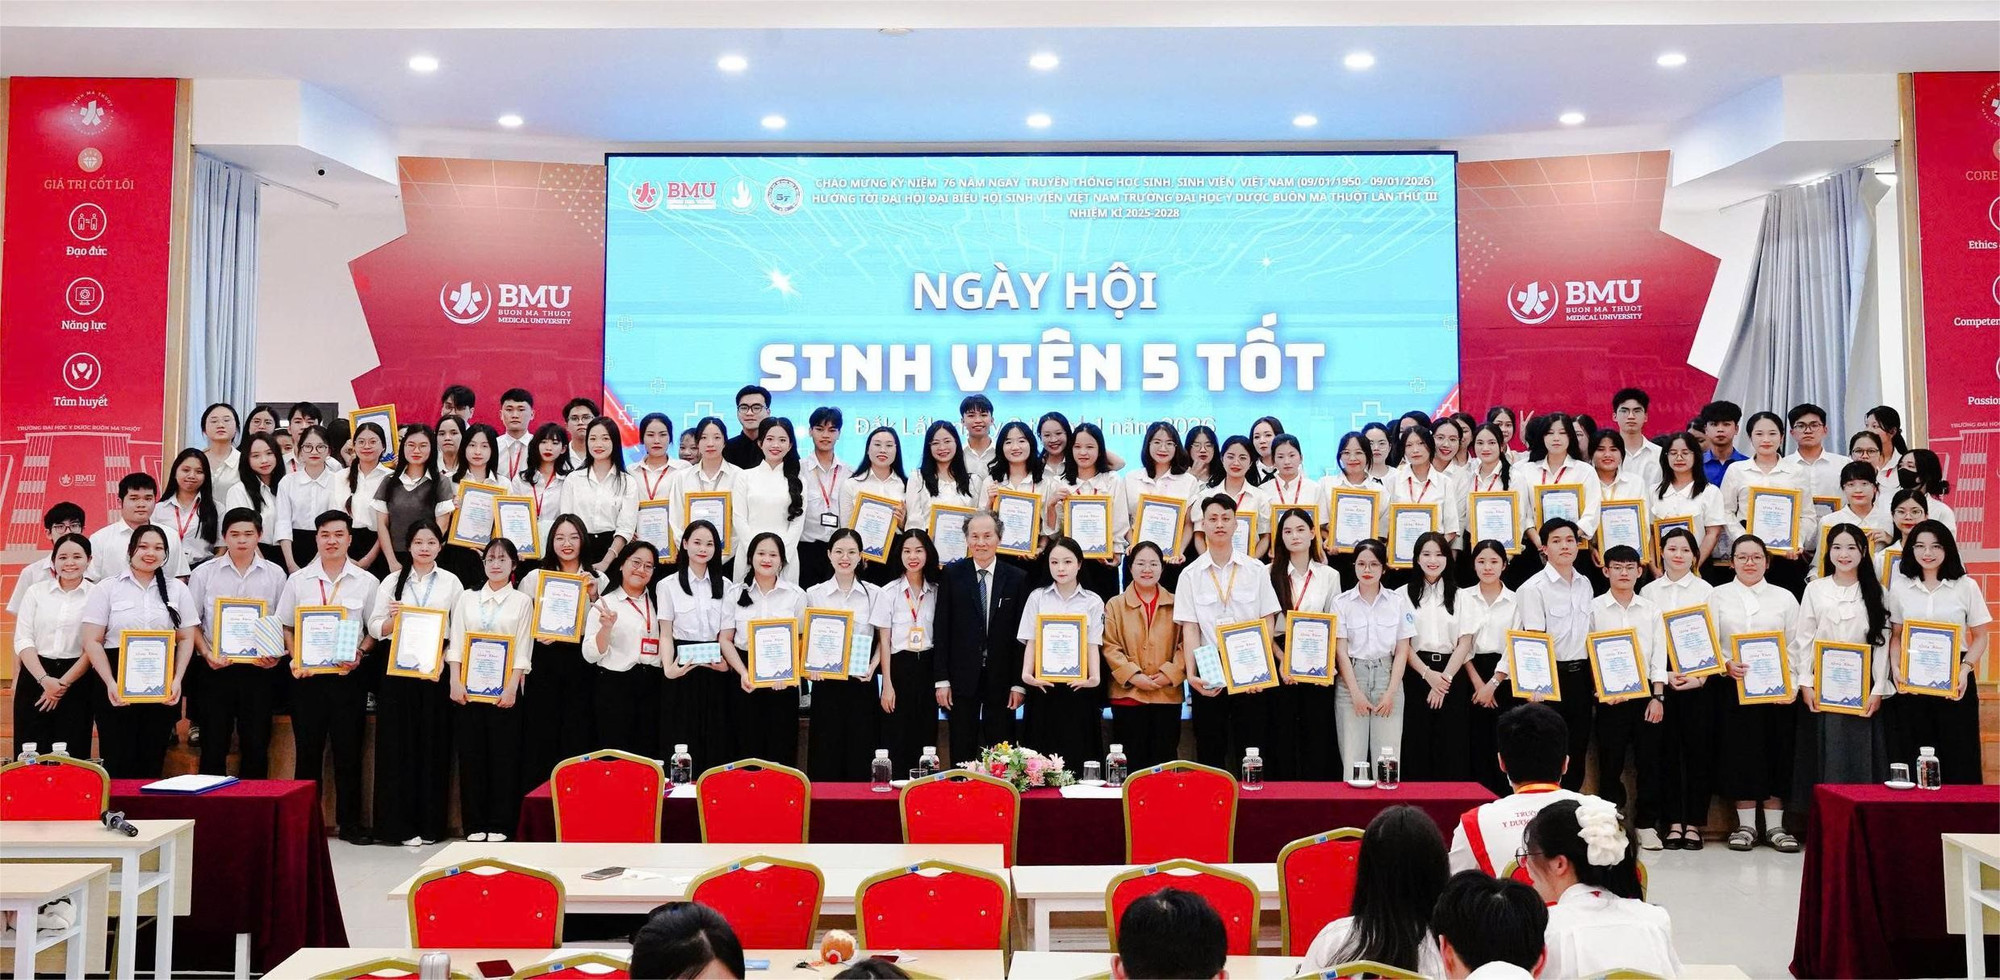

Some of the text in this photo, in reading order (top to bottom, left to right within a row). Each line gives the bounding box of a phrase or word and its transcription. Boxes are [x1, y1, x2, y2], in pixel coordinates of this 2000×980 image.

[44, 174, 134, 192] GIÁ TRỊ CỐT LÕI
[907, 176, 937, 190] NIỆM
[943, 178, 956, 188] 76
[1072, 174, 1114, 187] THỐNG
[1177, 177, 1205, 187] SINH
[1207, 175, 1235, 187] VIÊN
[1240, 175, 1265, 188] VIỆT
[1267, 176, 1295, 187] NAM
[1297, 176, 1361, 188] (09/01/1950
[1369, 175, 1434, 187] 09/01/2026)
[1965, 170, 1998, 181] CORE
[667, 182, 717, 198] BMU
[881, 194, 901, 206] ĐẠI
[904, 190, 926, 206] HỘI
[928, 193, 949, 206] ĐẠI
[981, 191, 1002, 205] HỘI
[1005, 193, 1033, 203] SINH
[1036, 191, 1063, 203] VIÊN
[1065, 190, 1090, 204] VIỆT
[1093, 193, 1120, 202] NAM
[1175, 192, 1196, 205] ĐẠI
[1225, 192, 1232, 202] Y
[1235, 191, 1270, 204] DƯỢC
[1272, 190, 1306, 202] BUÔN
[1309, 192, 1327, 202] MA
[1329, 189, 1369, 203] THUỘT
[1397, 189, 1421, 201] THỨ
[1424, 191, 1438, 201] III
[1069, 206, 1107, 220] NHIỆM
[1126, 208, 1180, 218] 2025-2028
[66, 245, 108, 258] Đạo đức
[1968, 240, 1998, 250] Ethics
[497, 283, 573, 309] BMU
[913, 261, 1158, 320] NGÀY HỘI
[1564, 279, 1643, 304] BMU
[61, 320, 107, 333] Năng lực
[530, 317, 572, 325] UNIVERSITY
[757, 311, 1326, 393] SINH VIÊN 5 TỐT
[53, 394, 108, 409] Tâm huyết
[1968, 396, 2000, 406] Passio
